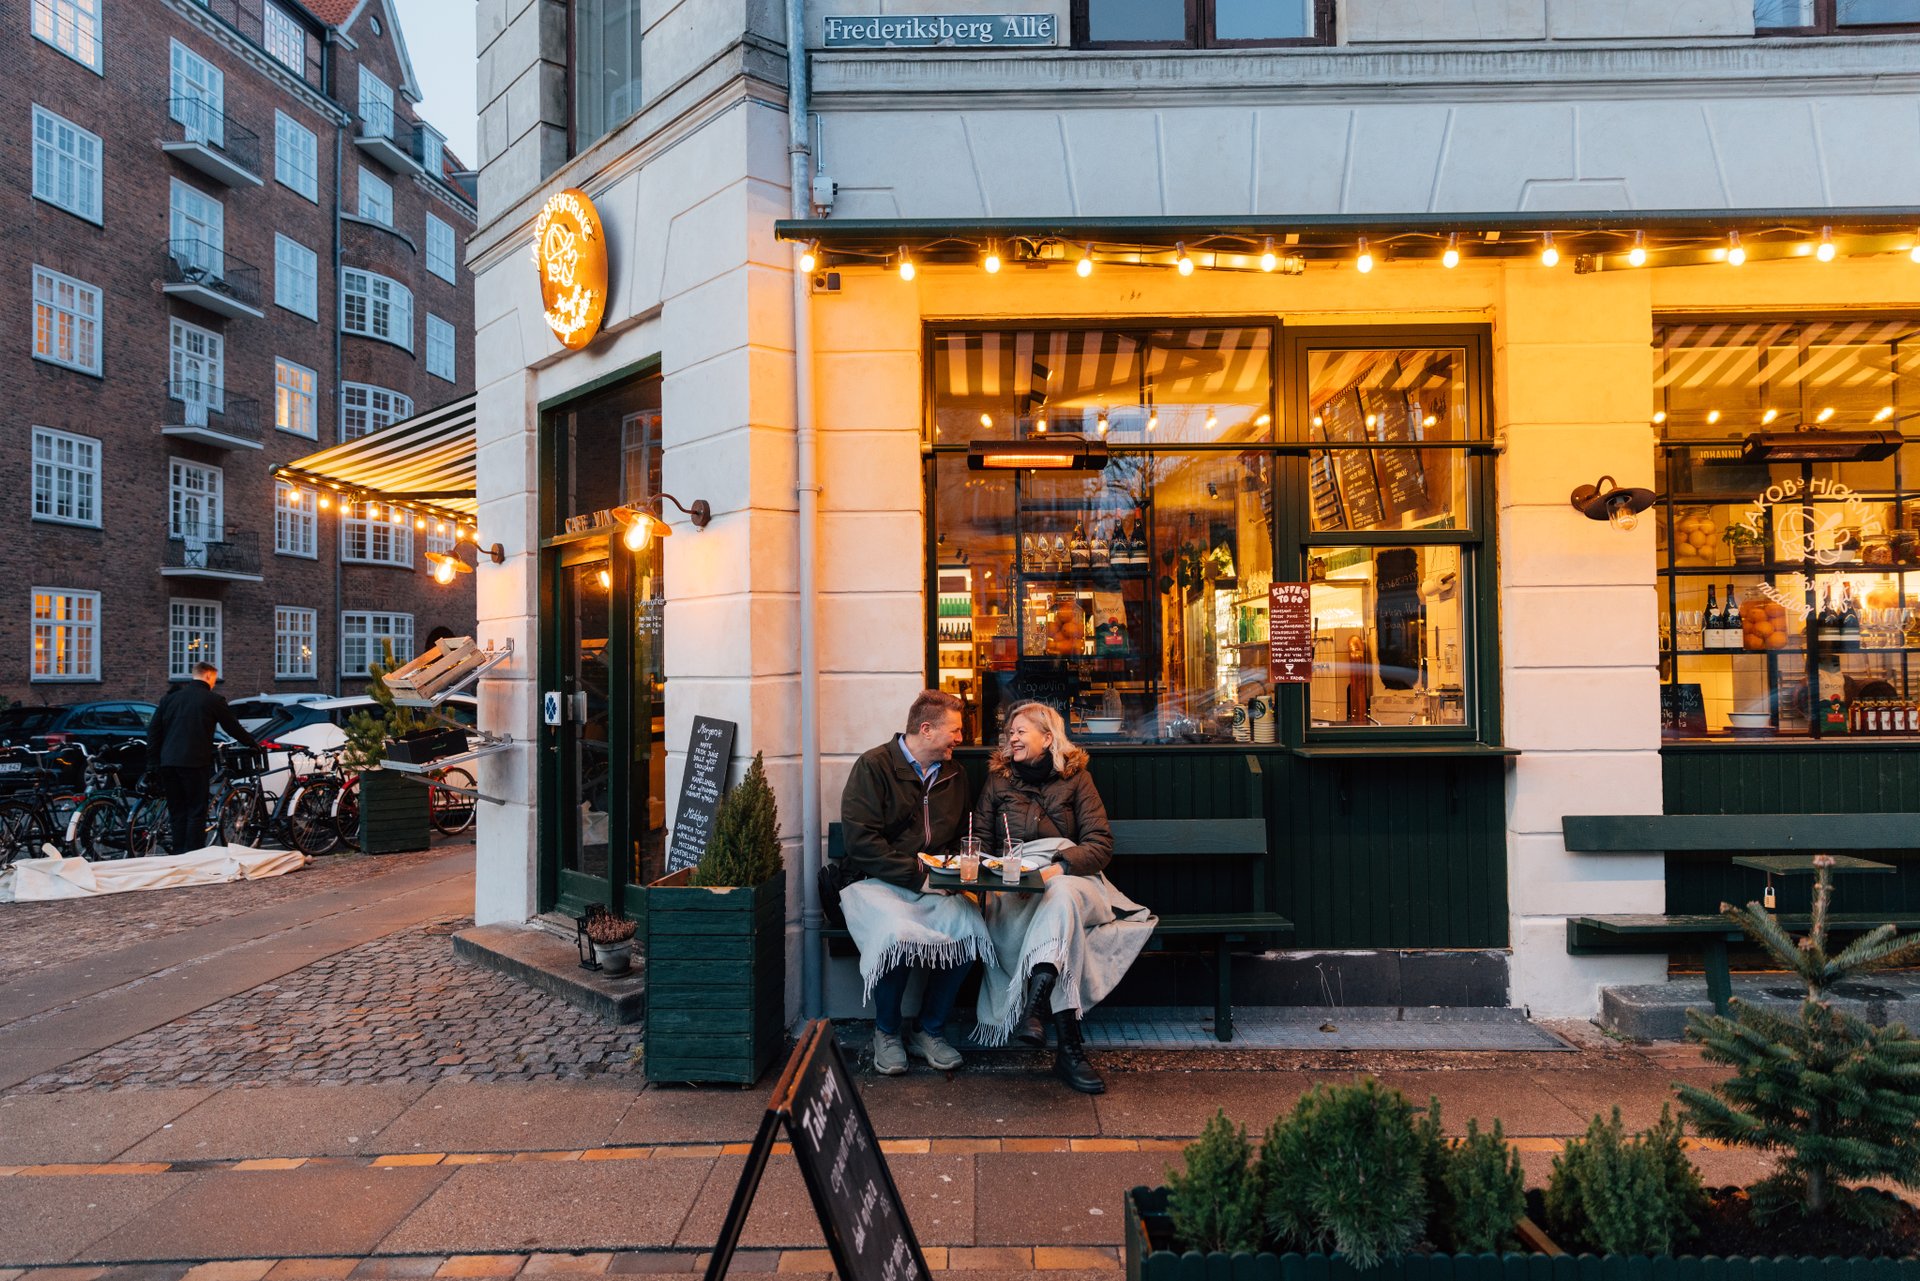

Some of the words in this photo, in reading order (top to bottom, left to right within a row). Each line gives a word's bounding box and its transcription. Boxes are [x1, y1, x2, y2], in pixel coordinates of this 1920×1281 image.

[828, 18, 994, 43] Frederiksberg
[1003, 17, 1051, 38] Allé
[1272, 586, 1301, 596] KAFFE
[1277, 595, 1289, 603] TO
[1291, 596, 1303, 604] GO
[1757, 581, 1814, 622] middag
[803, 1096, 828, 1152] Take
